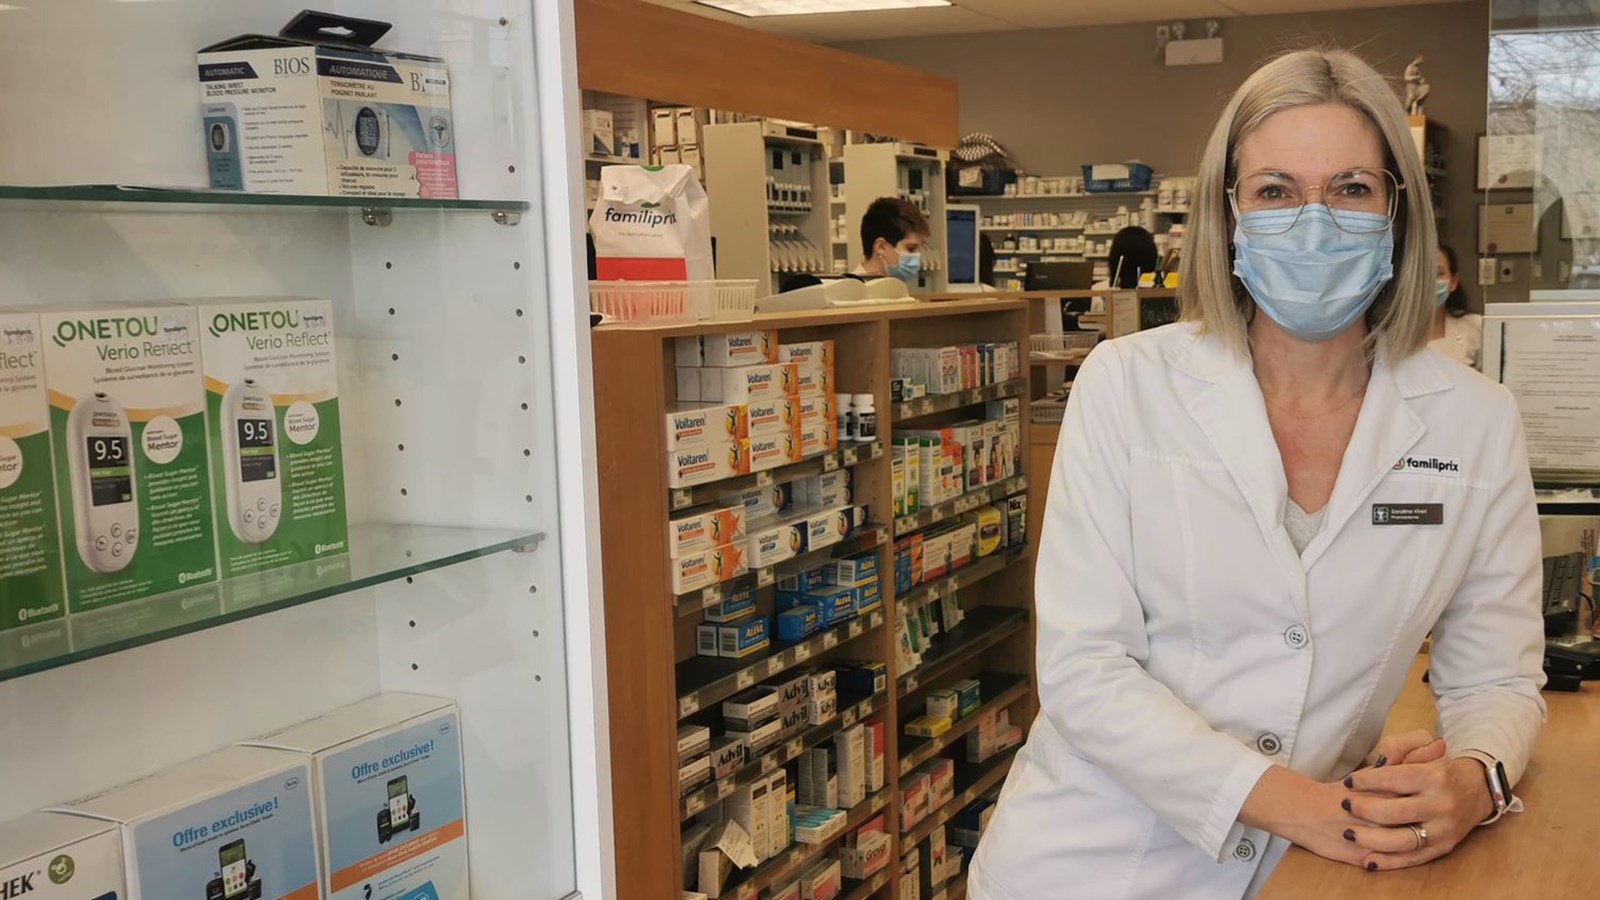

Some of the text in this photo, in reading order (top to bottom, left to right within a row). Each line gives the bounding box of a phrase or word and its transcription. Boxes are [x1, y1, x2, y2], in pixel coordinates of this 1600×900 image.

[204, 67, 245, 77] AUTOMATIC
[273, 57, 310, 75] BIOS
[329, 65, 387, 79] AUTOMATIQUE
[225, 88, 250, 96] PRESSURE
[604, 207, 678, 228] familiprix
[212, 310, 299, 332] ONETOU
[57, 316, 158, 342] ONETOU
[246, 331, 329, 350] Verio Reflect
[728, 337, 753, 347] Voltaren
[97, 341, 193, 361] Verio Reflect
[789, 347, 812, 357] Voltaren
[747, 373, 772, 384] Voltaren
[750, 407, 775, 419] Voltaren
[289, 423, 316, 433] Mentor
[674, 417, 705, 430] Voltaren
[244, 422, 268, 440] 9.5
[94, 439, 123, 461] 9.5
[147, 441, 178, 451] Mentor
[751, 441, 776, 453] Voltaren
[677, 453, 708, 467] Voltaren
[1406, 457, 1459, 472] familiprix
[678, 521, 702, 533] Voltaren
[758, 533, 779, 545] Voltaren
[681, 557, 705, 569] Voltaren
[185, 567, 213, 581] Bluetooth
[28, 603, 60, 617] Bluetooth
[782, 678, 809, 703] Advil
[782, 705, 808, 729] Advil
[351, 740, 434, 780] Offre exclusive!
[717, 744, 743, 767] Advil
[172, 826, 208, 848] Offre
